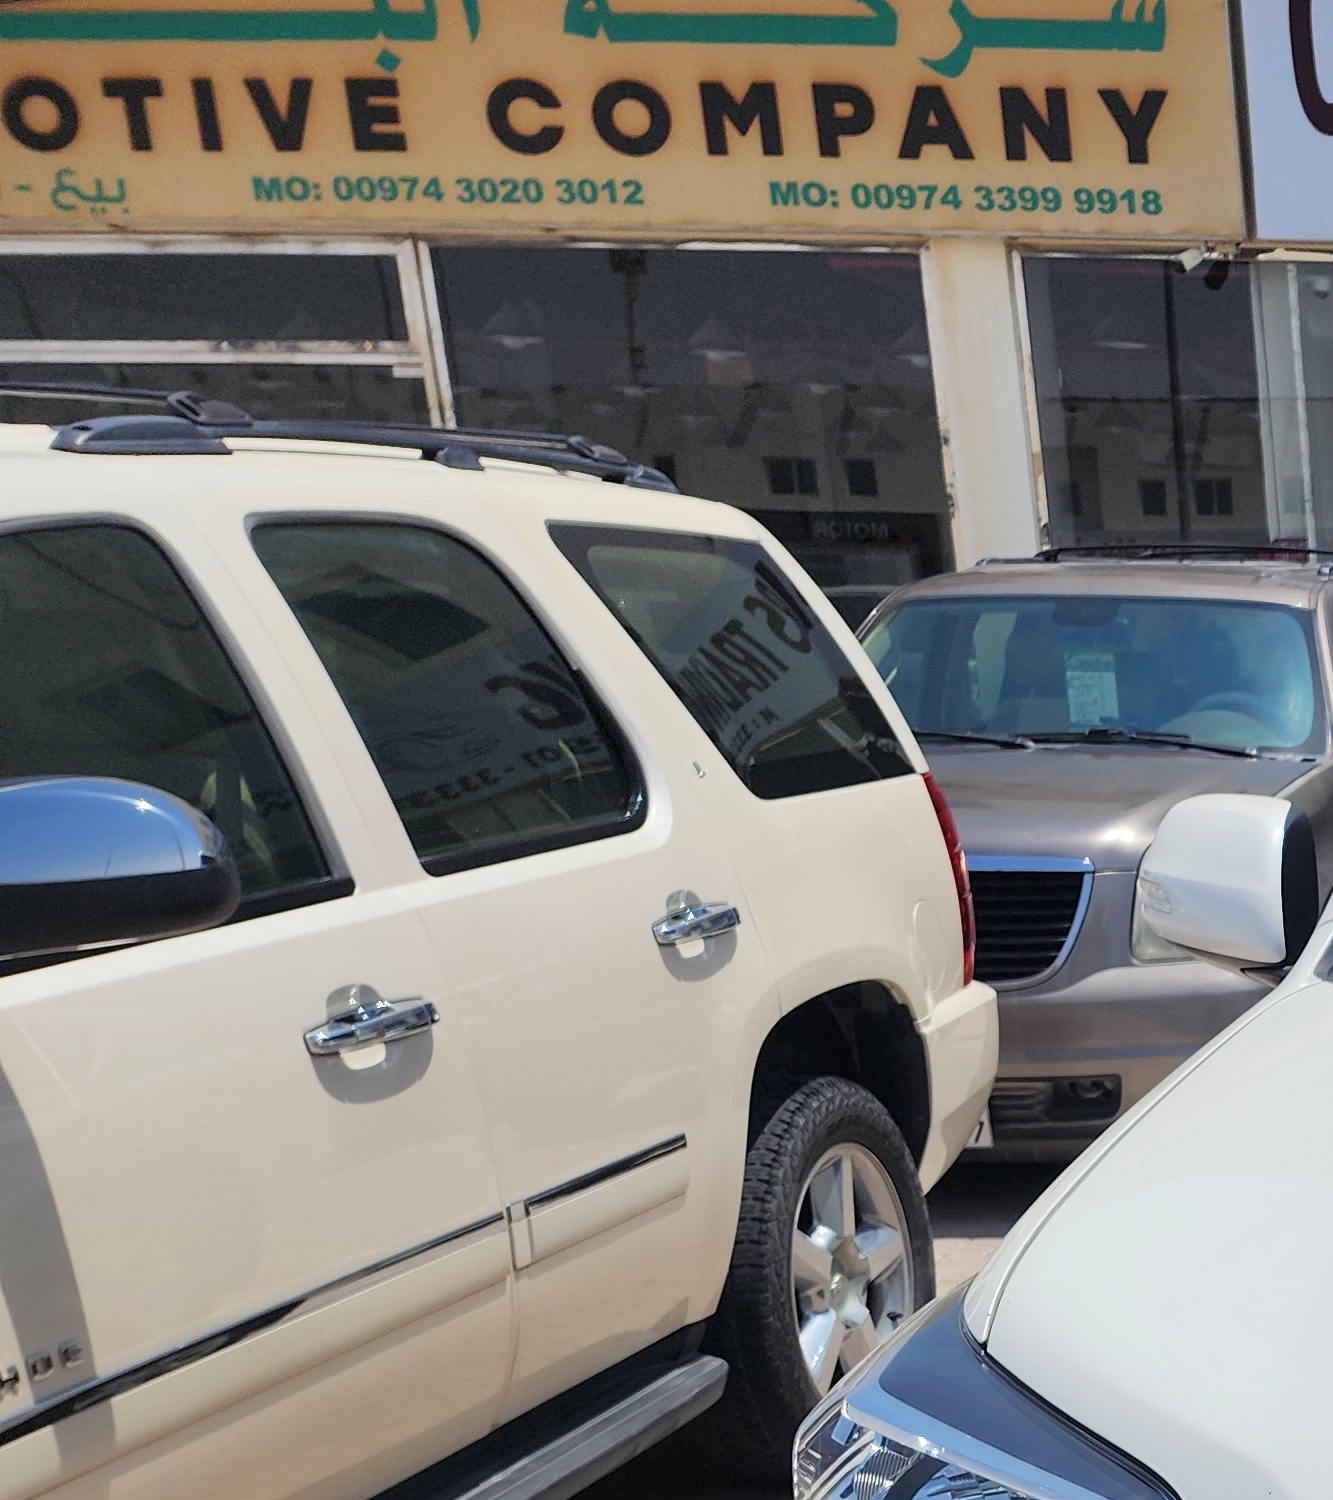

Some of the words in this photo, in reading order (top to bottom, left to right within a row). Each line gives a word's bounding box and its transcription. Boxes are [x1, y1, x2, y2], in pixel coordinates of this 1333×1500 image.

[1, 74, 408, 153] OTIVE
[486, 77, 1168, 165] COMPANY
[252, 176, 323, 203] MO:
[332, 177, 446, 204] 00974
[456, 178, 544, 205] 3020
[556, 178, 645, 206] 3012
[769, 181, 840, 209] MO:
[851, 183, 962, 211] 00974
[974, 185, 1063, 214] 3399
[1073, 187, 1164, 217] 9918
